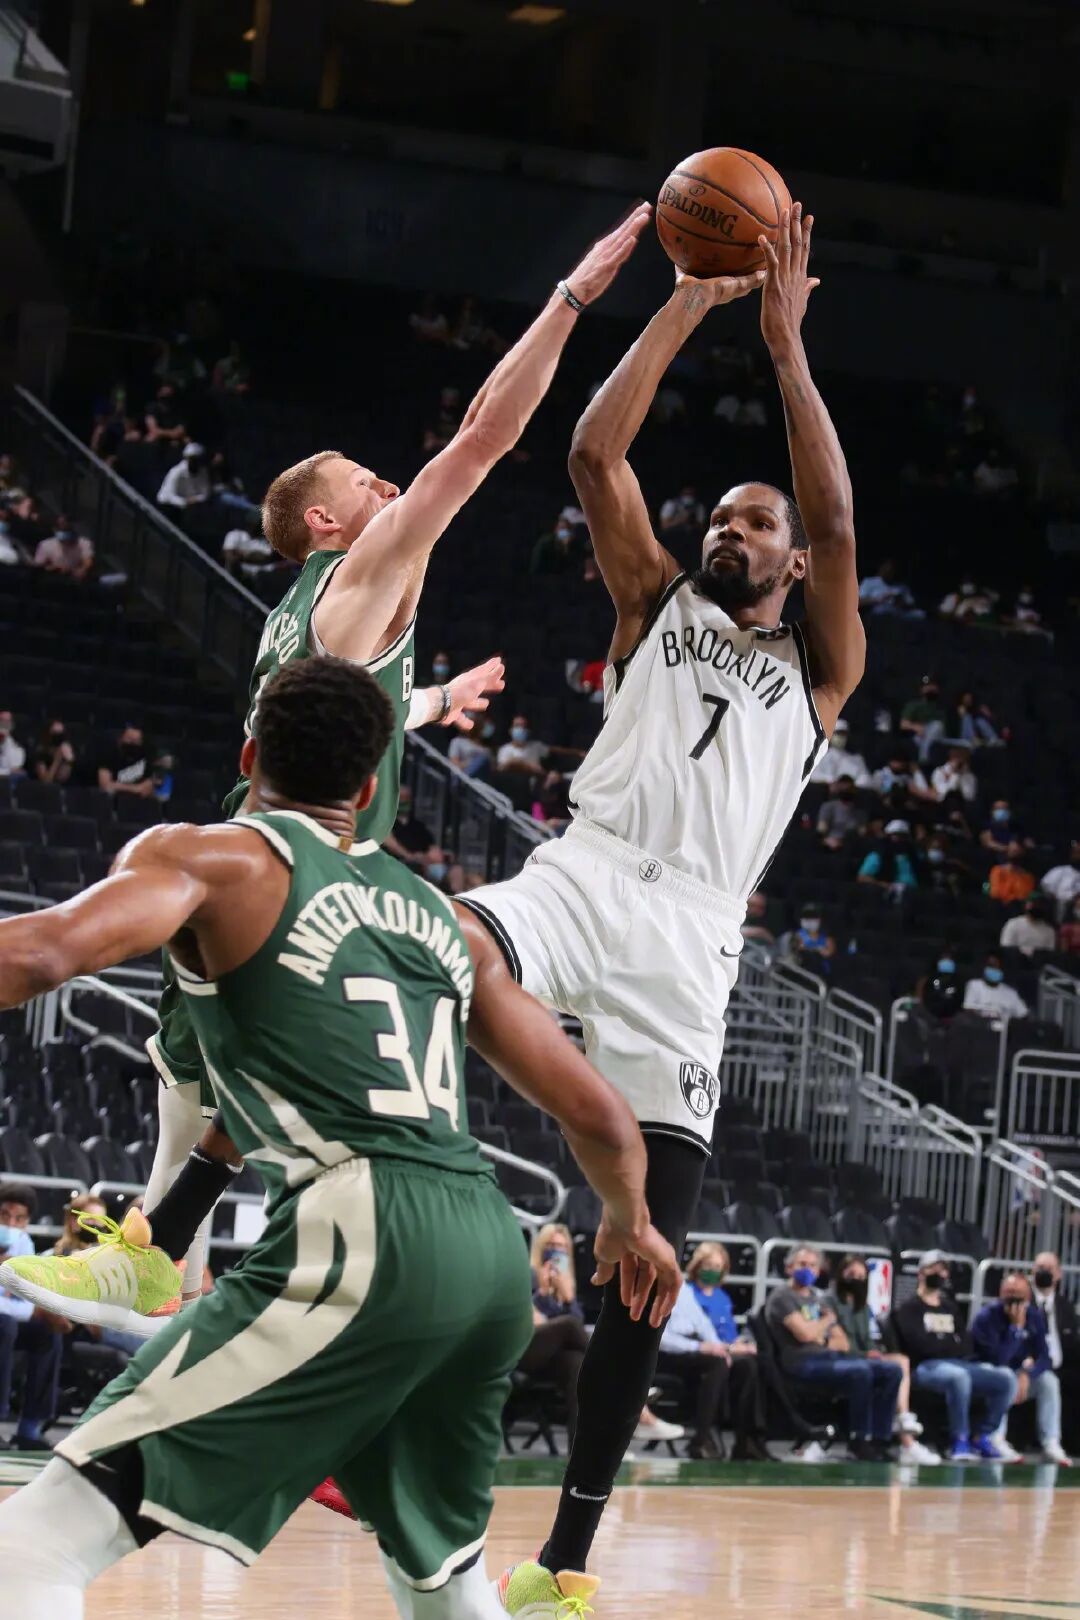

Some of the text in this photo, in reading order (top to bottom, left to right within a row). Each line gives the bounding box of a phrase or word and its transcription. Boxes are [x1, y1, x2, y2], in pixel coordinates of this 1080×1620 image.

[662, 626, 790, 710] BROOKLYN
[688, 692, 730, 761] 7
[343, 977, 460, 1132] 34
